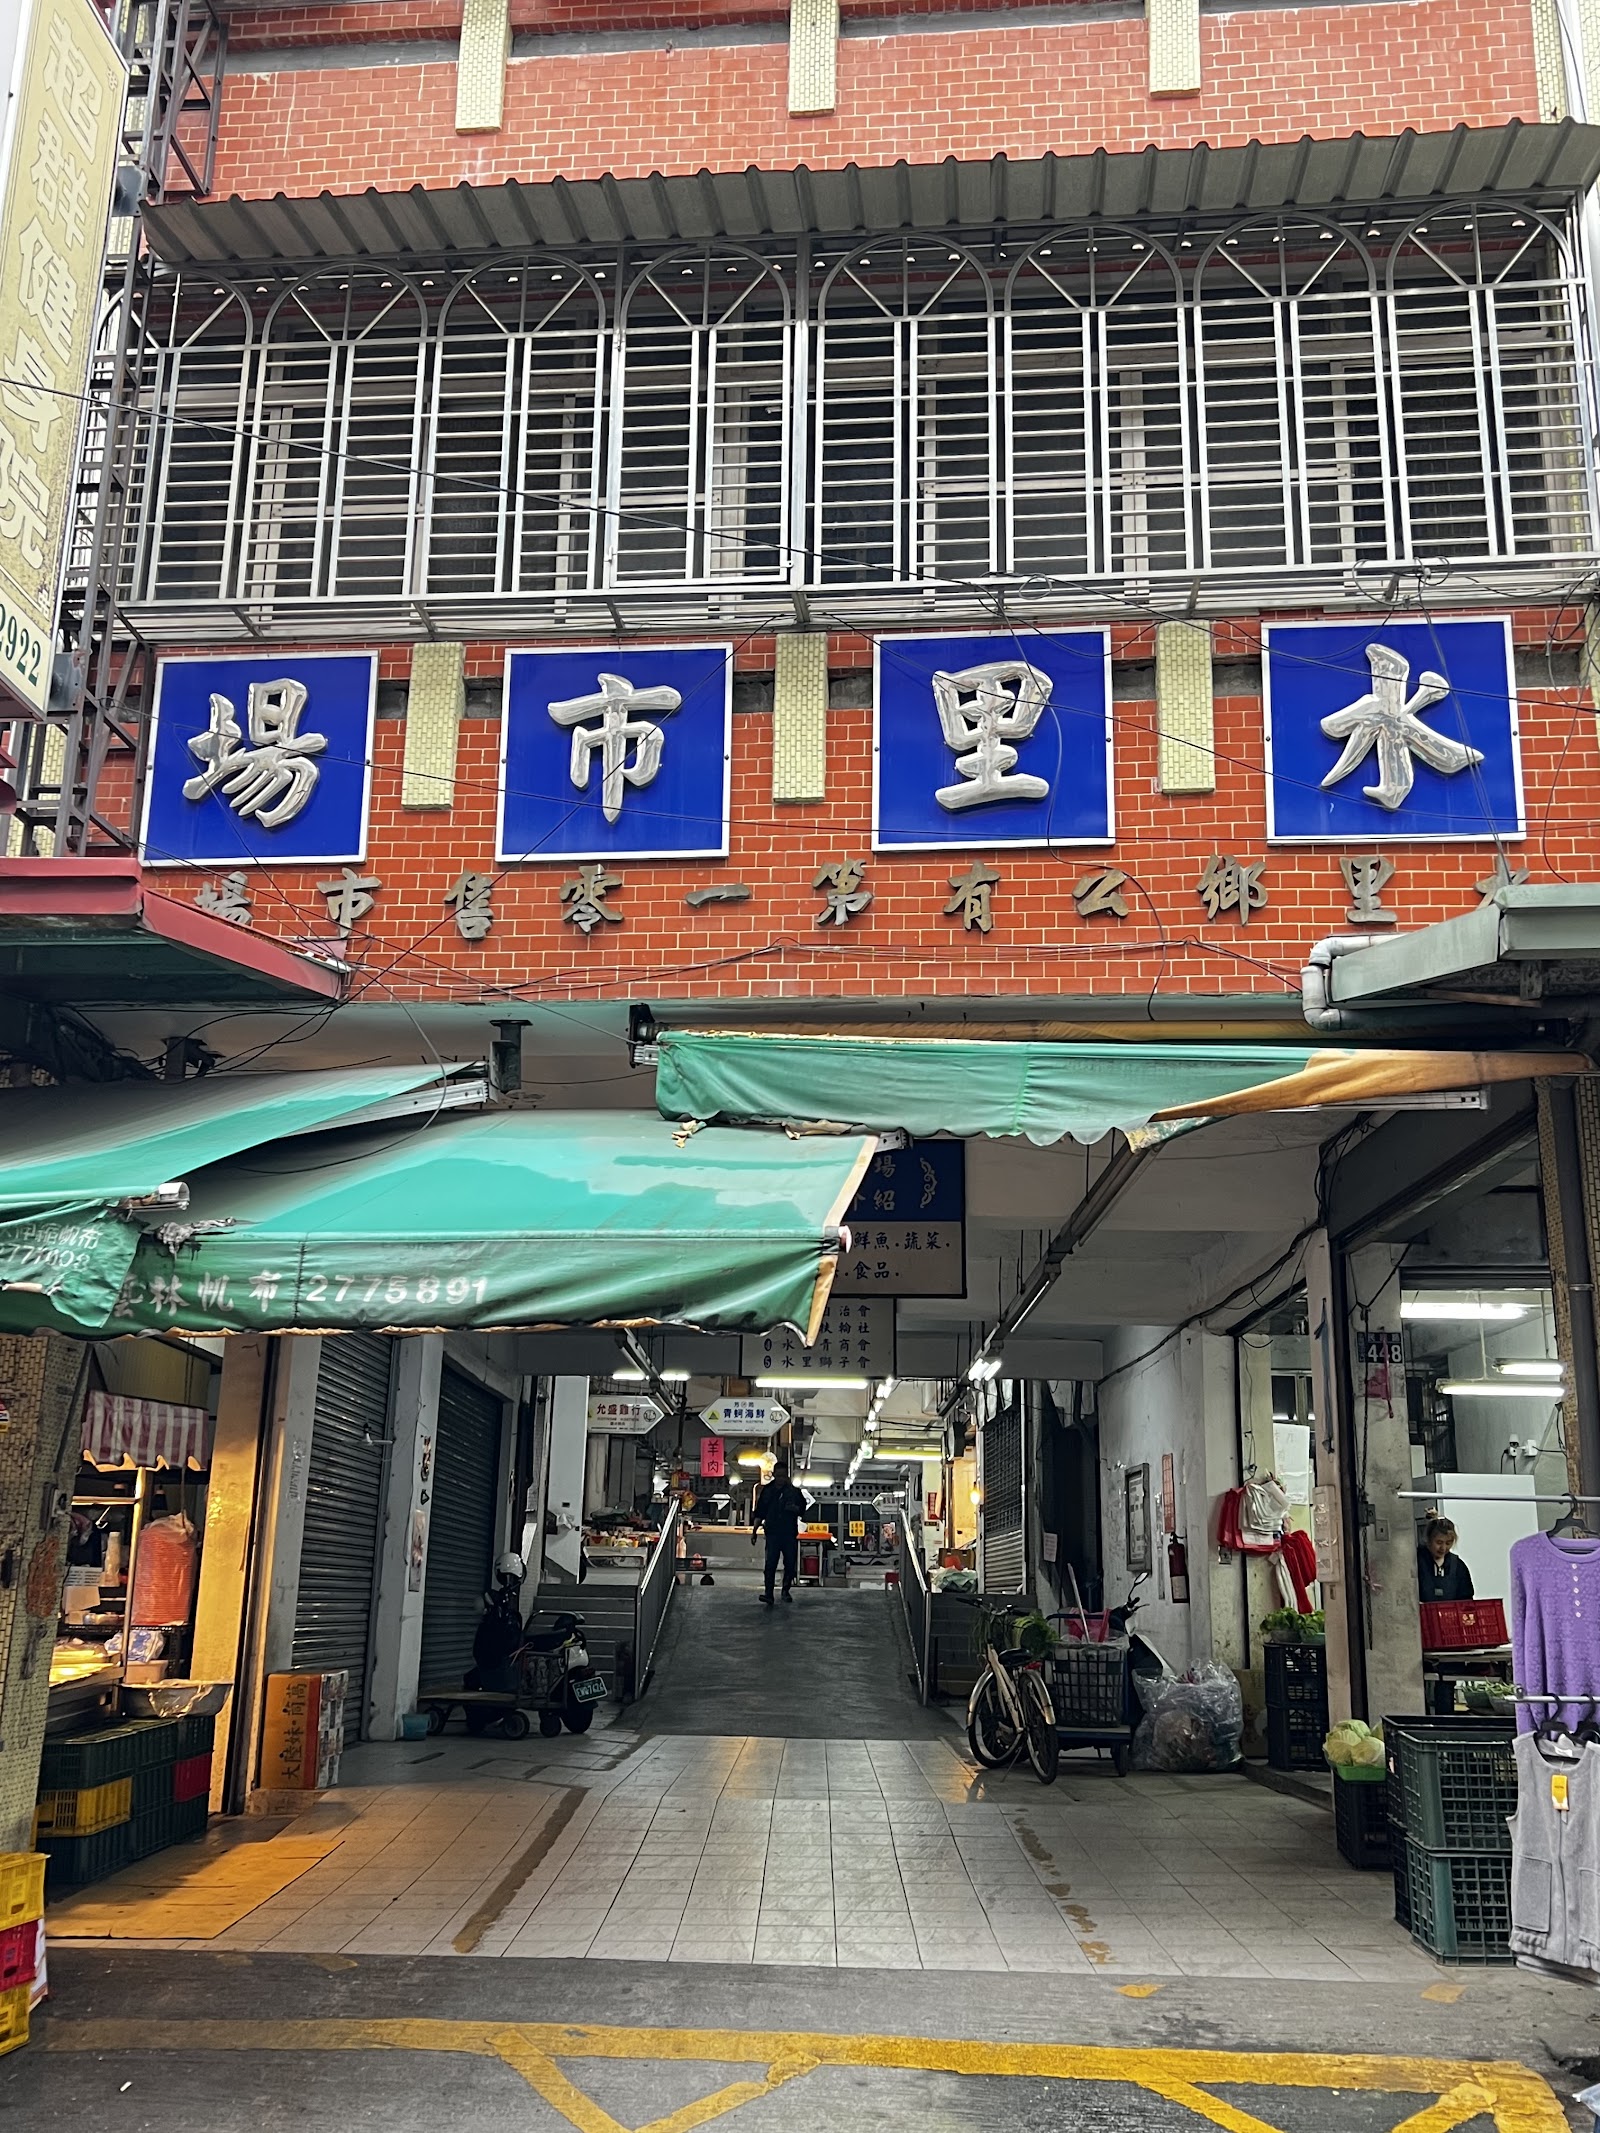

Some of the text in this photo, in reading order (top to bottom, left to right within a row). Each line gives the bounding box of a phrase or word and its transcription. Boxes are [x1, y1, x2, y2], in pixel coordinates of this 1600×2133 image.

[305, 1274, 488, 1304] 2775891
[782, 1338, 871, 1352] 水青商會
[1367, 1343, 1402, 1363] 448
[707, 1440, 719, 1474] 羊肉
